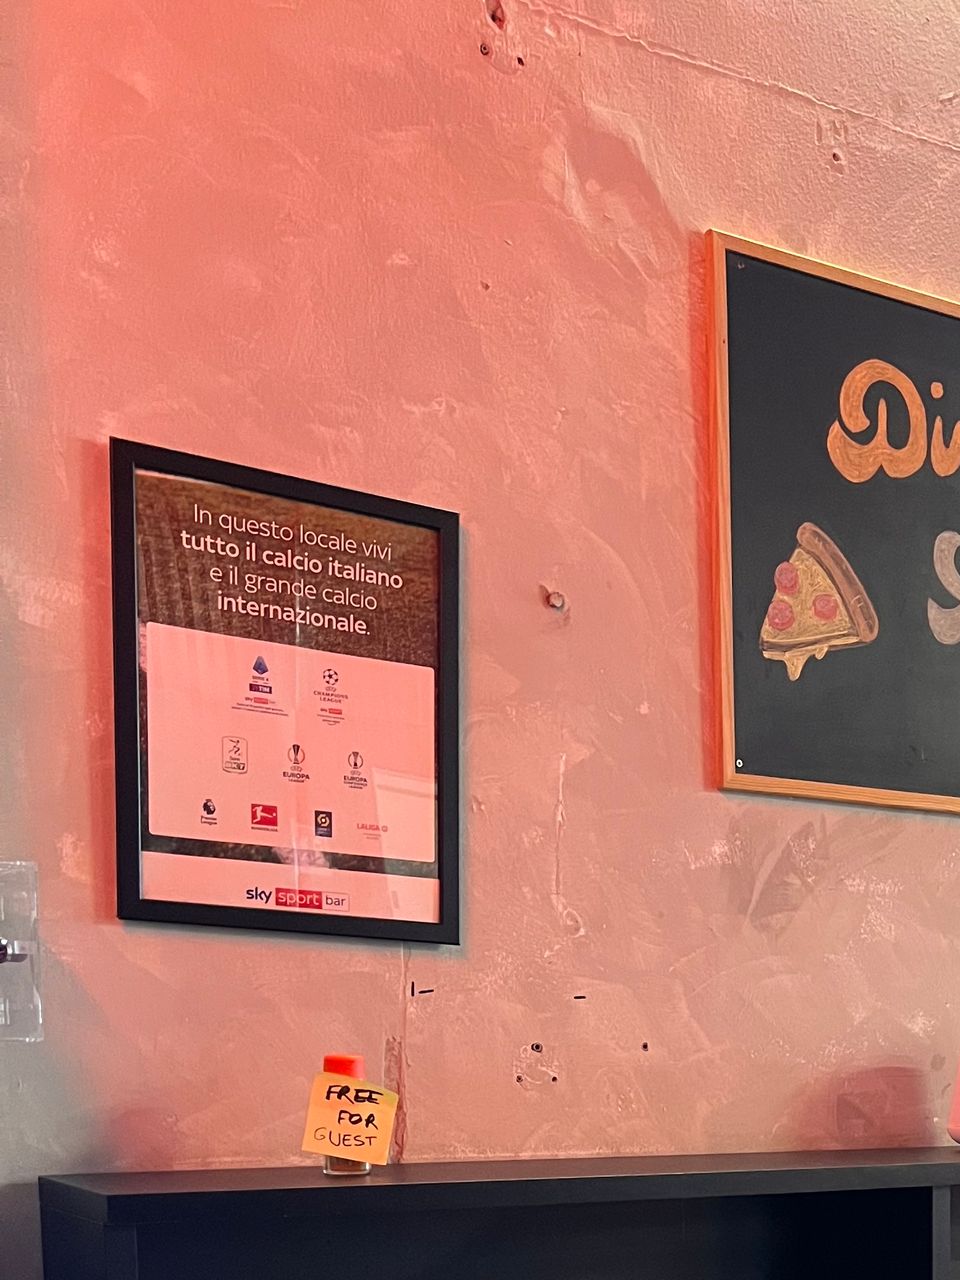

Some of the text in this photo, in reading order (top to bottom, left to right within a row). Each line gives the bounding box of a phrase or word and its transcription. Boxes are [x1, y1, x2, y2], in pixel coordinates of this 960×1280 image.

[194, 504, 393, 561] In questo locale vivi
[180, 530, 403, 589] tutto il calcio italiano
[210, 565, 378, 611] e il grande calcio
[218, 590, 371, 636] internazionale.
[282, 771, 310, 780] EUROPA
[343, 775, 368, 783] EUROPA
[246, 887, 346, 906] sky sport bar
[325, 1084, 384, 1105] FREE
[338, 1109, 378, 1130] FOR
[314, 1127, 377, 1147] GUEST
